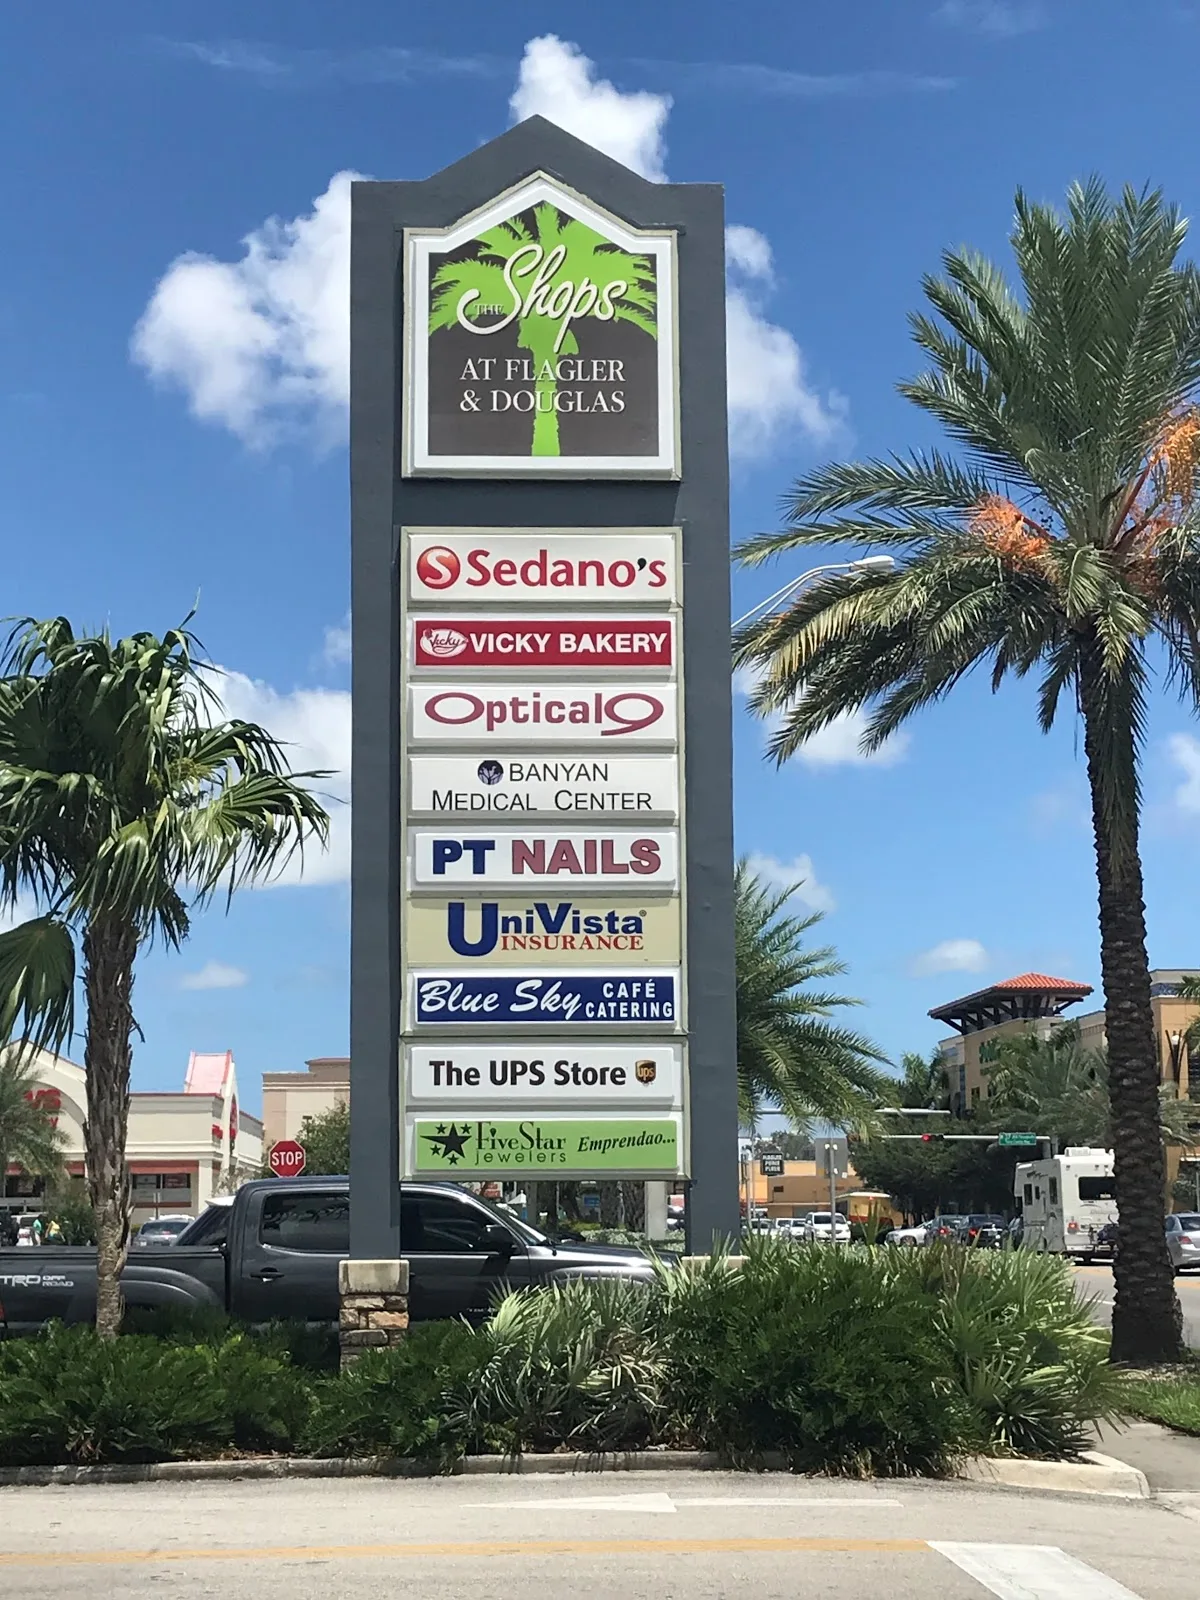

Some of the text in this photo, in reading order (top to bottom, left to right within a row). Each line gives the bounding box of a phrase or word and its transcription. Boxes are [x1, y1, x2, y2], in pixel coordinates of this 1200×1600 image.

[456, 243, 628, 354] Shops
[459, 358, 626, 382] AT FLAGLER
[459, 389, 626, 413] & DOUGLAS
[465, 549, 668, 588] Sedano's
[469, 633, 668, 654] VICKY BAKERY
[508, 762, 609, 782] BANYAN
[432, 789, 653, 811] MEDICAL CENTER
[432, 838, 662, 875] PT NAILS
[501, 934, 645, 951] INSURANCE
[602, 978, 657, 998] CAFÉ
[419, 979, 583, 1020] Blue Sky
[585, 1001, 673, 1018] CATERING
[429, 1060, 627, 1086] The UPS Store
[638, 1067, 654, 1081] ups
[271, 1151, 303, 1166] STOP
[474, 1150, 567, 1166] jewelers
[0, 1274, 41, 1287] TRD
